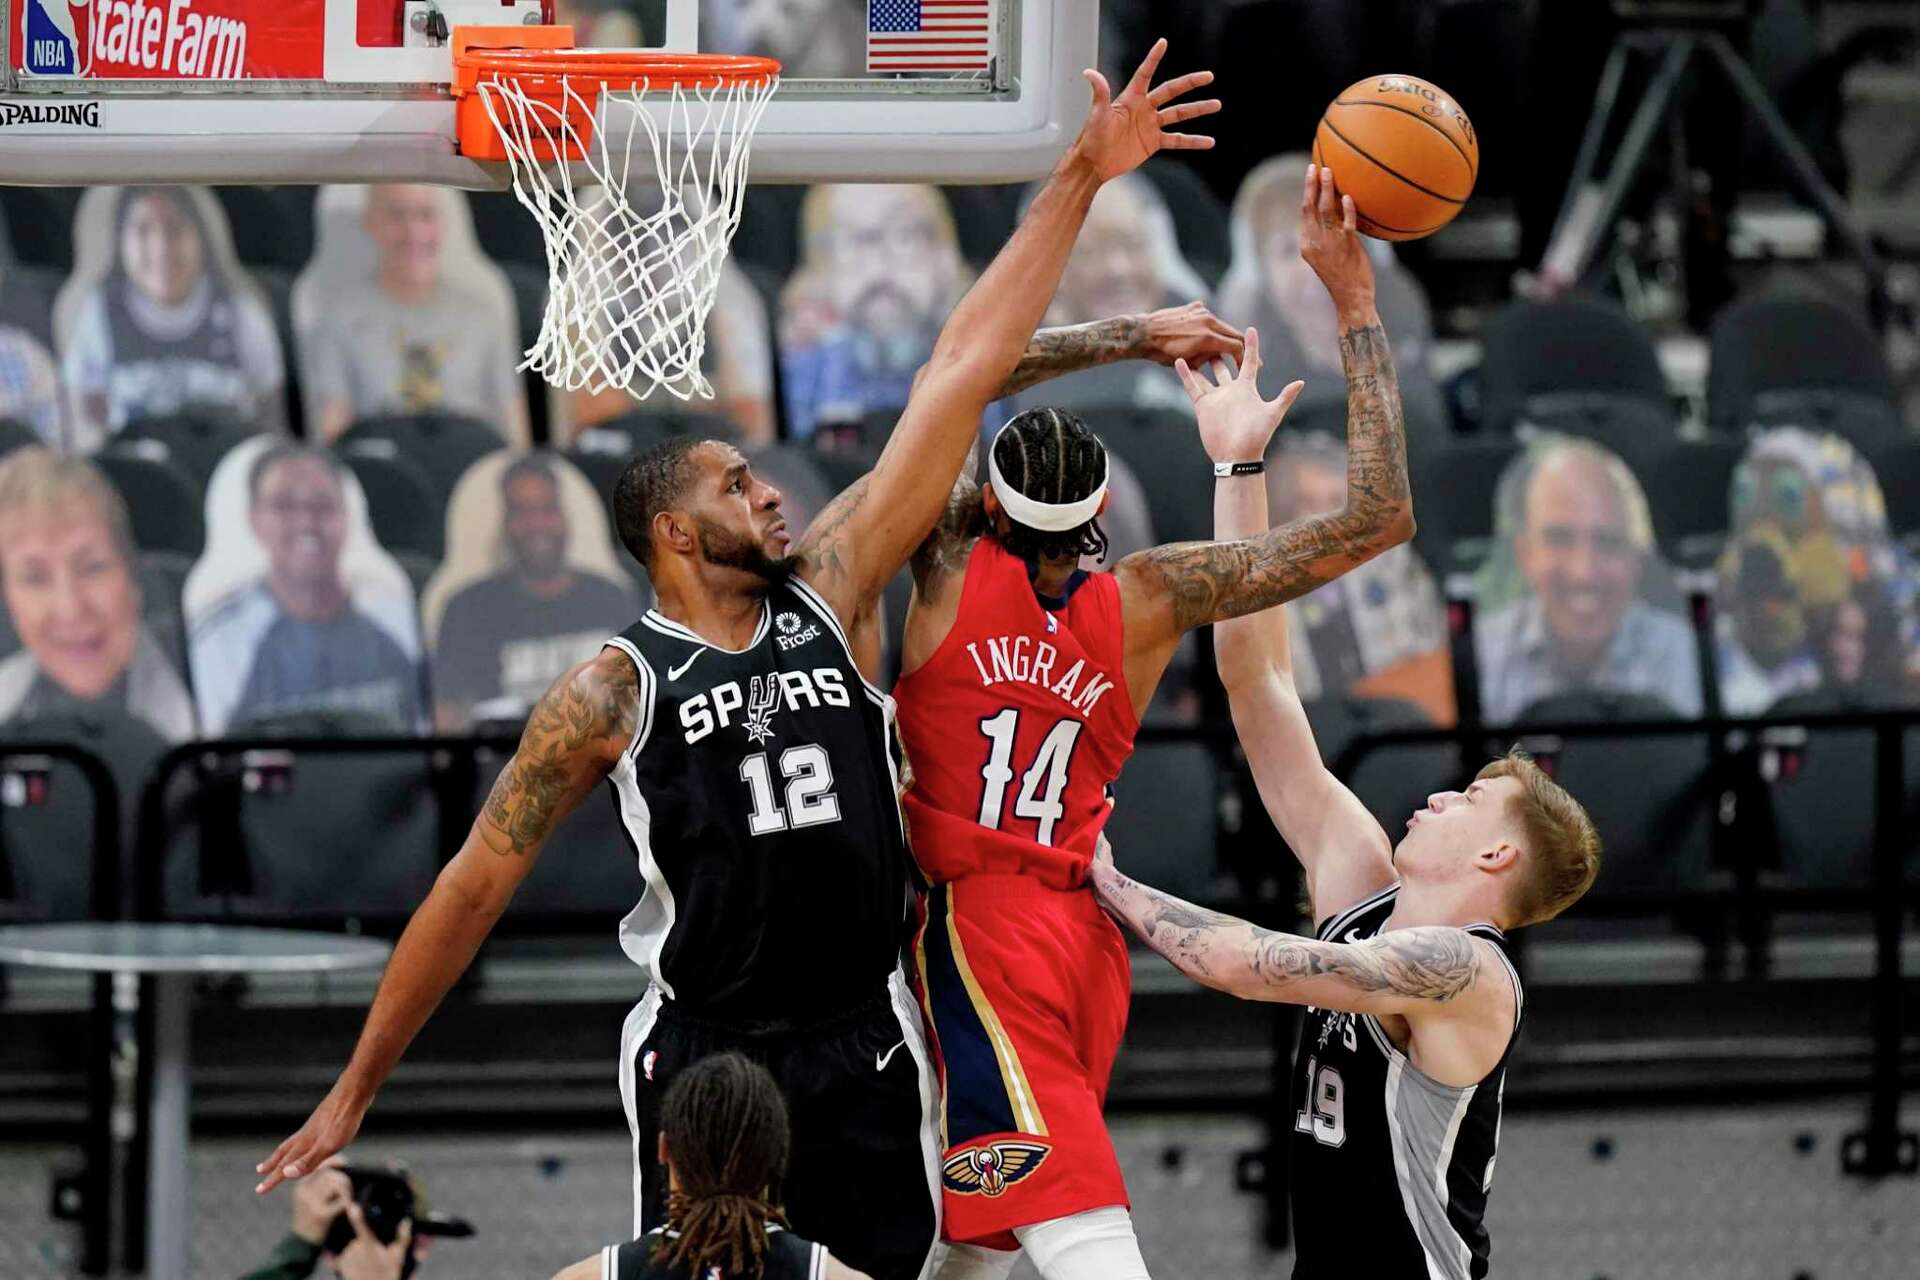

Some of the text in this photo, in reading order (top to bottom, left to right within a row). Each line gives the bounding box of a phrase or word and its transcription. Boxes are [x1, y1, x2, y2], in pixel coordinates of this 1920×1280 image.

[33, 39, 66, 67] NBA
[775, 624, 821, 651] Frost
[966, 635, 1114, 718] INGRAM
[679, 667, 850, 746] SPURS
[738, 743, 842, 836] 12
[980, 708, 1082, 847] 14
[1294, 1054, 1347, 1148] 19
